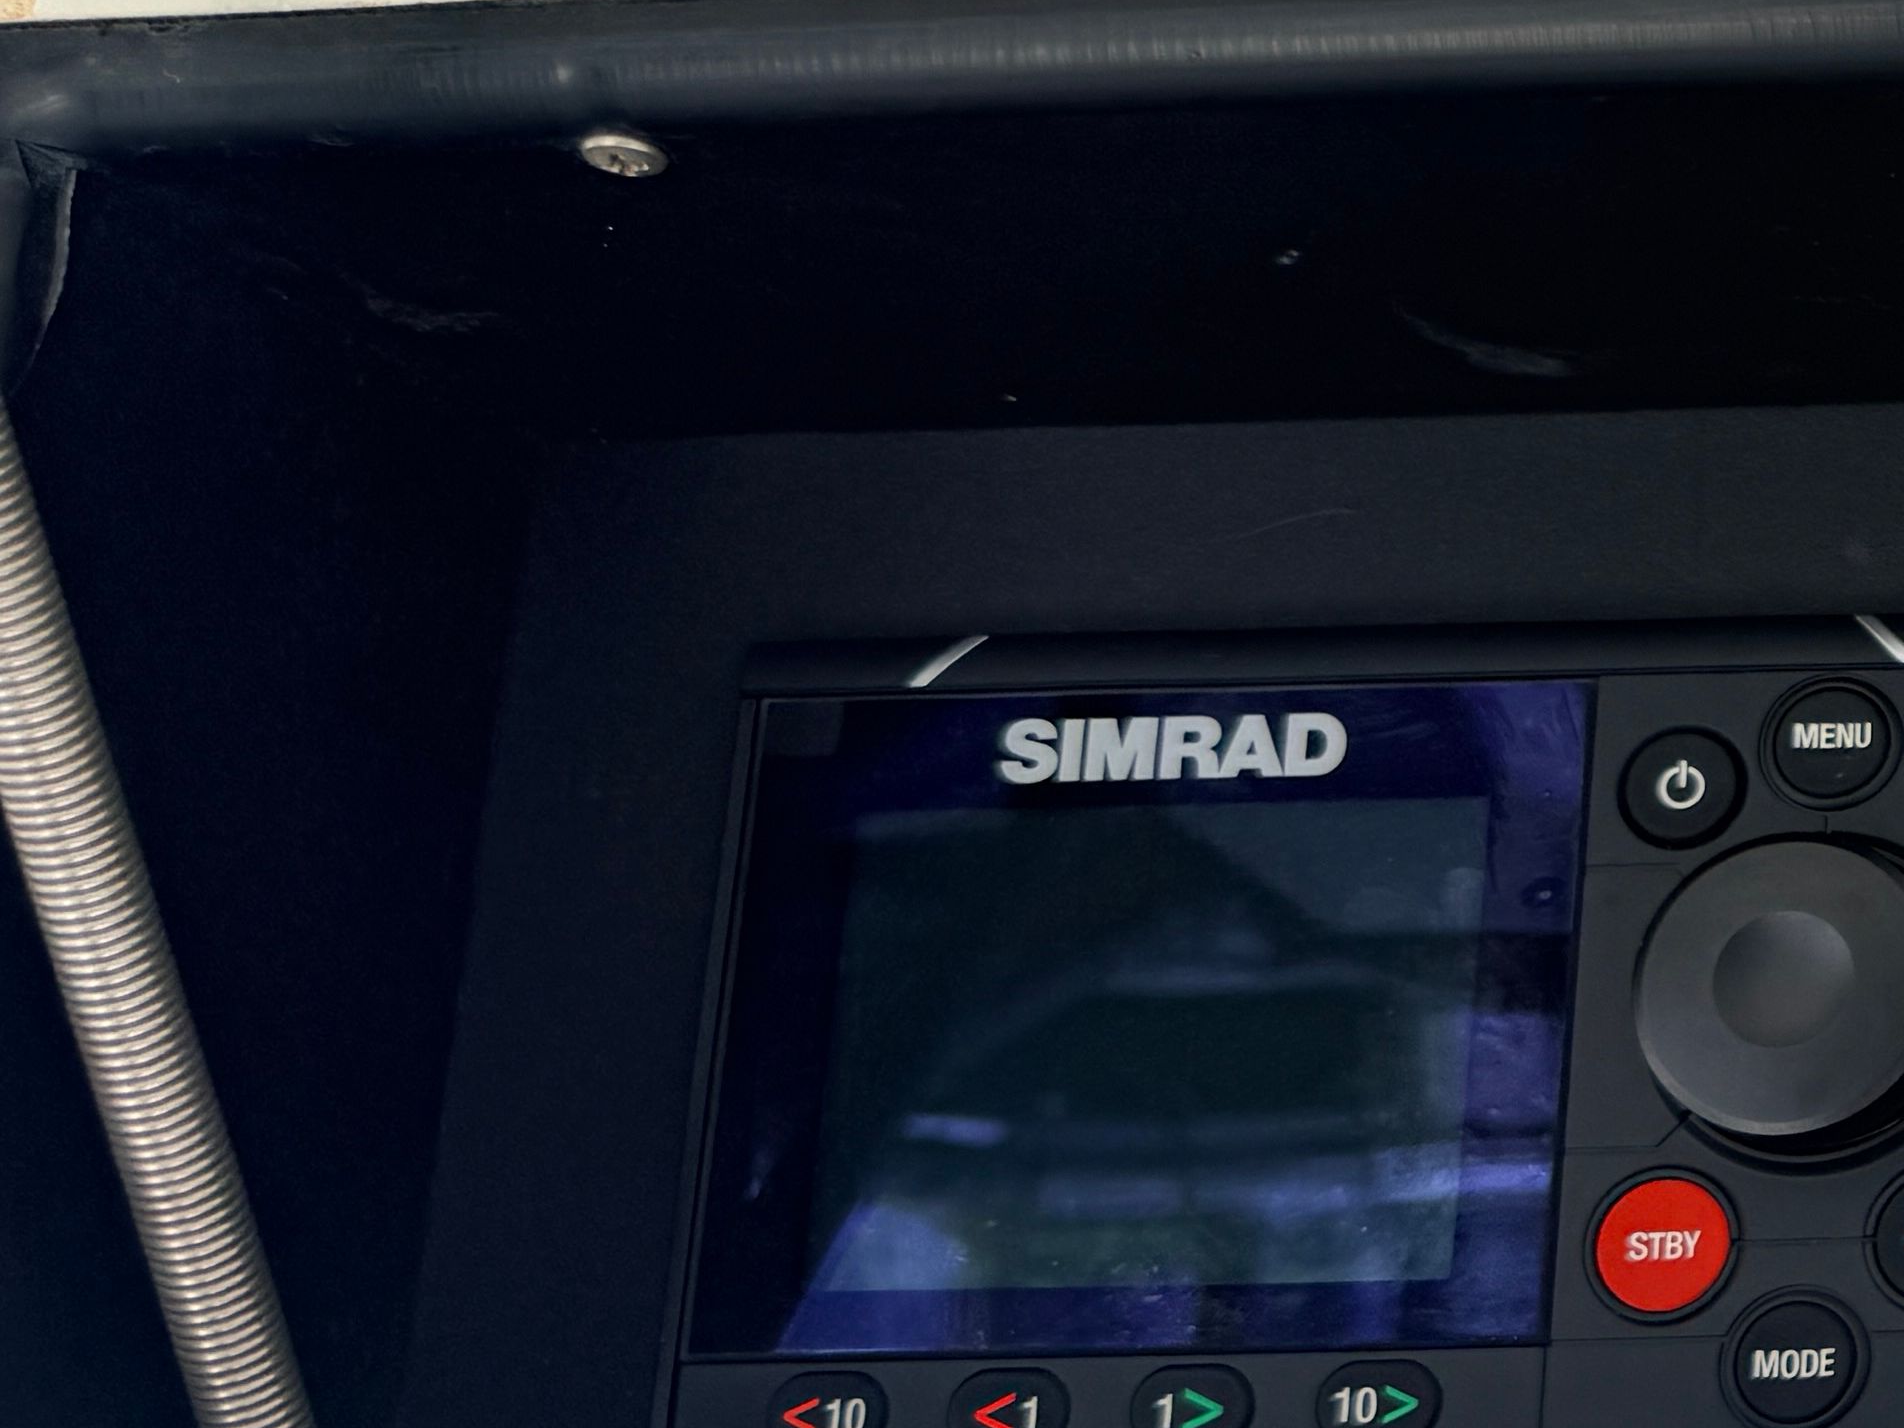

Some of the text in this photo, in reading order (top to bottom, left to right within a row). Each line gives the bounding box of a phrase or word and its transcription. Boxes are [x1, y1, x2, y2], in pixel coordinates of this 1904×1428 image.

[1000, 712, 1348, 784] SIMRAD
[1791, 722, 1872, 749] MENU
[1626, 1230, 1702, 1261] STBY
[1751, 1348, 1836, 1379] MODE
